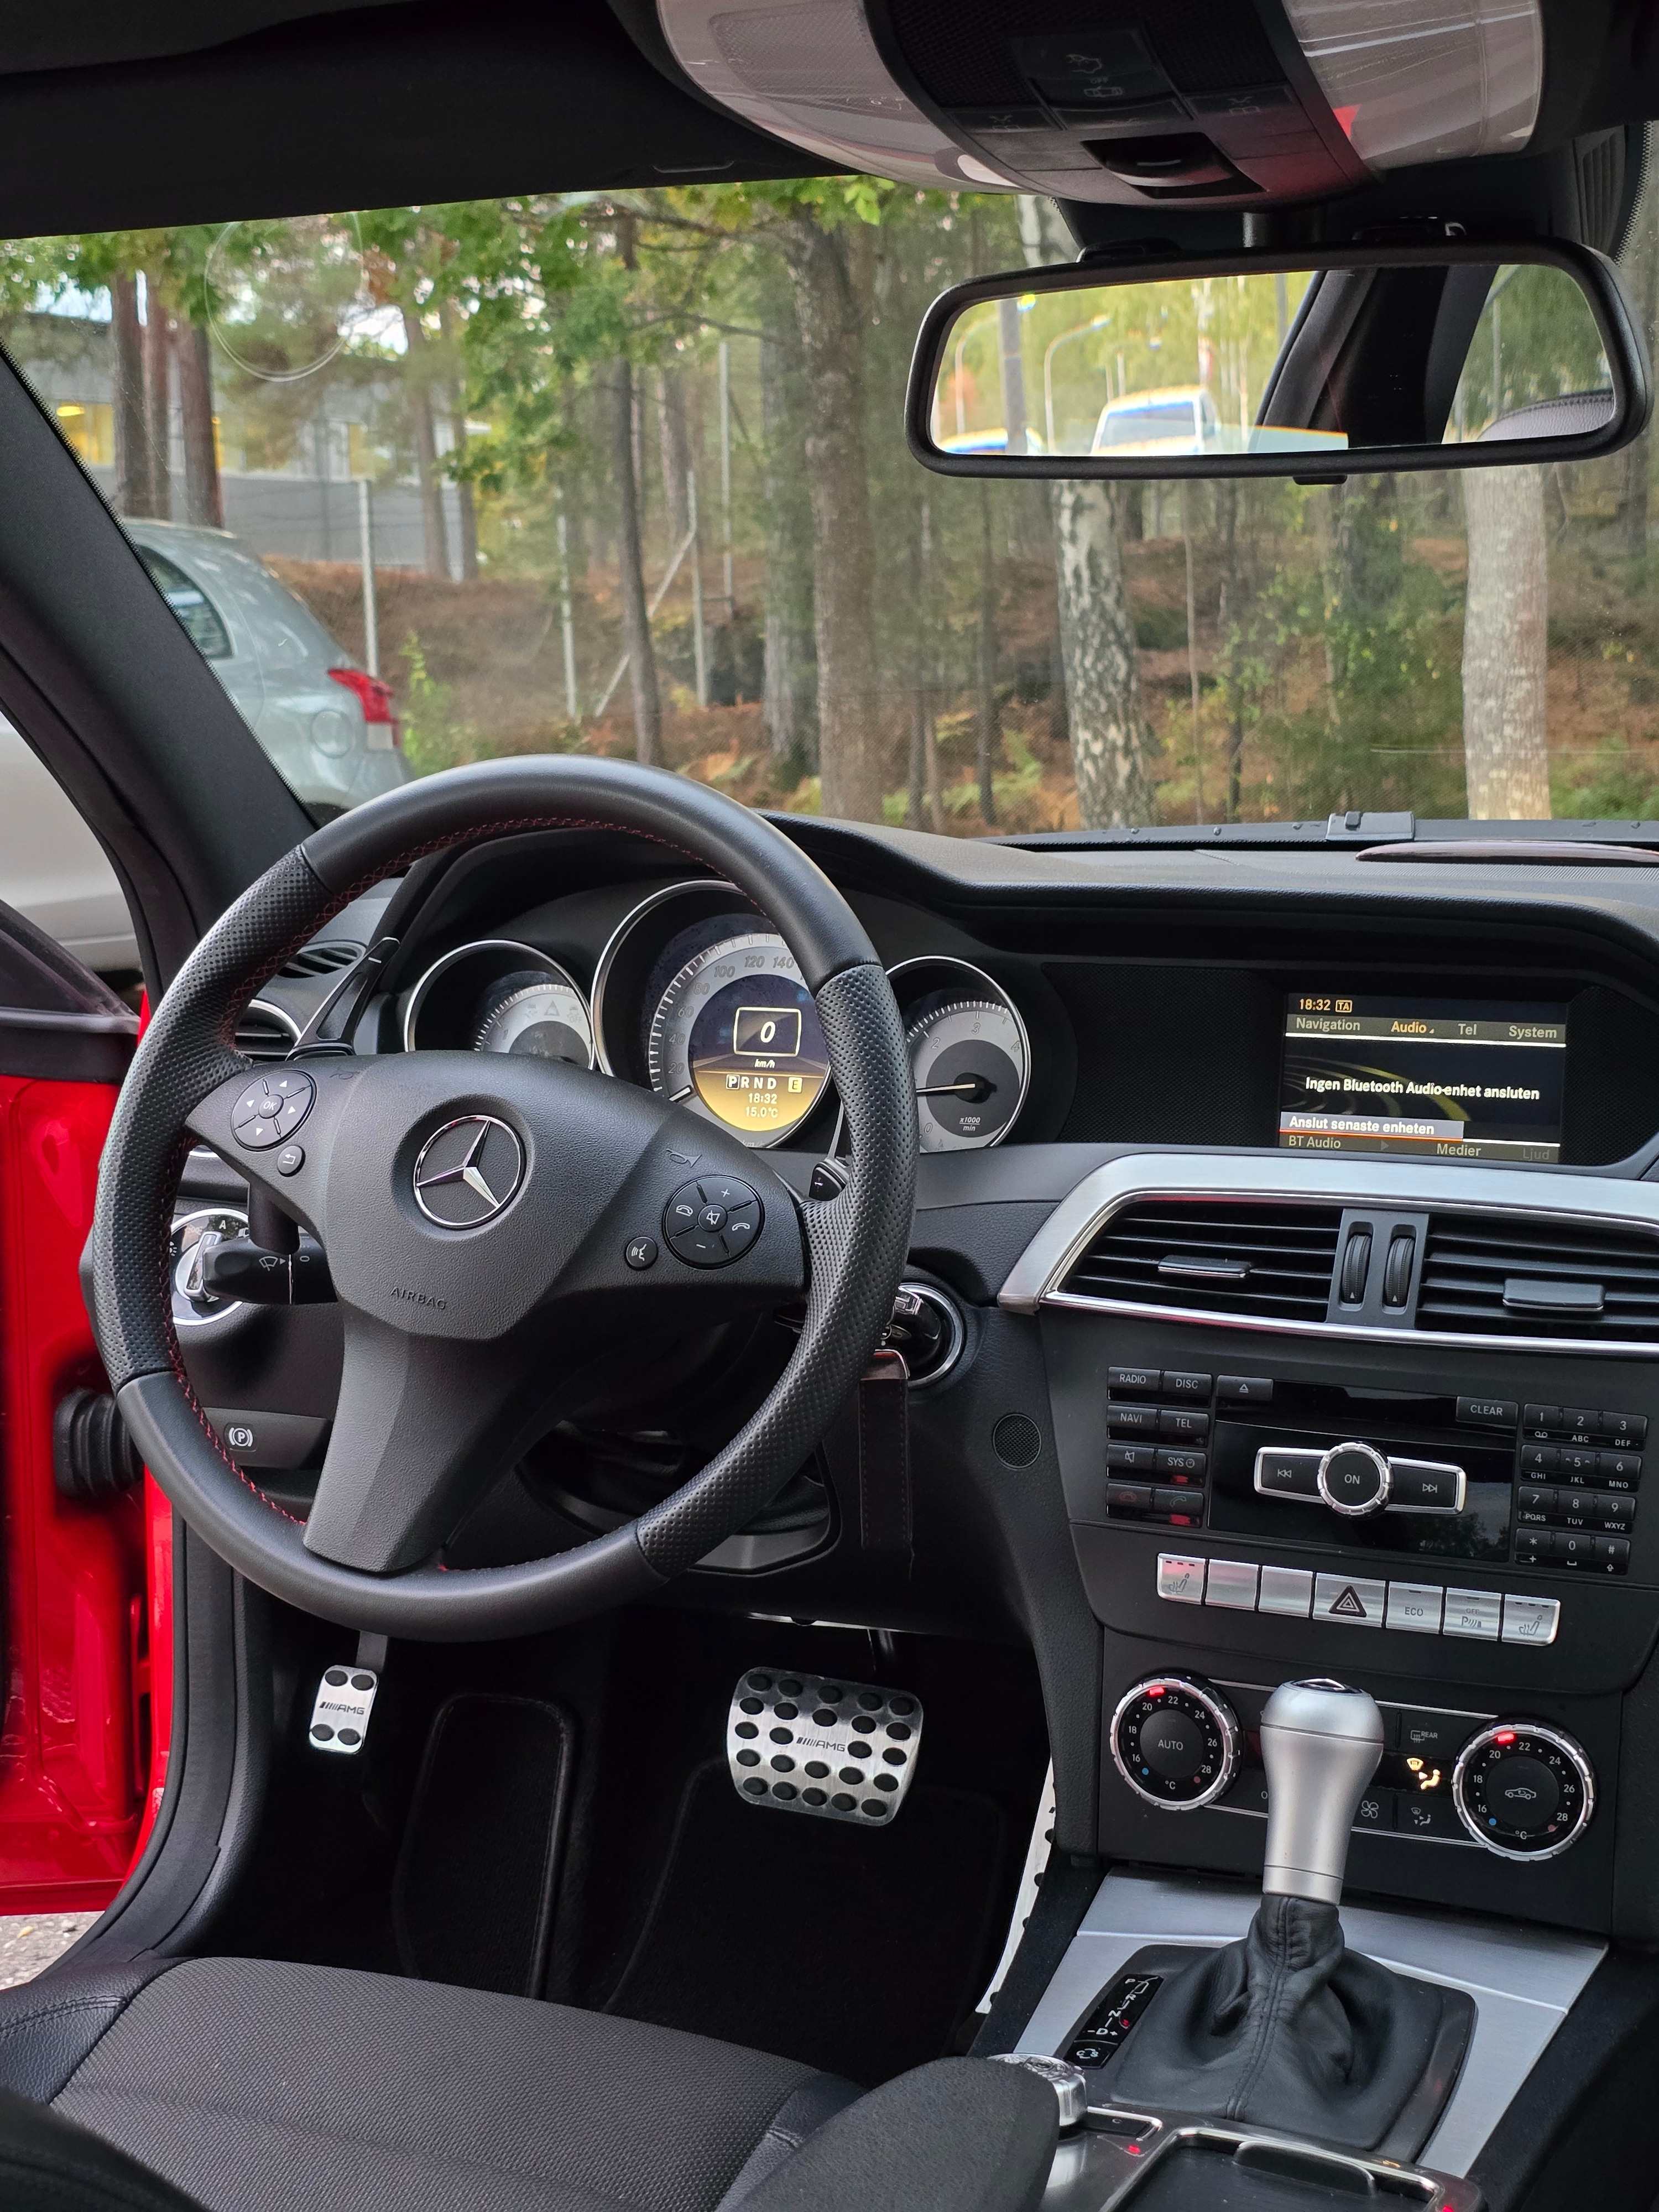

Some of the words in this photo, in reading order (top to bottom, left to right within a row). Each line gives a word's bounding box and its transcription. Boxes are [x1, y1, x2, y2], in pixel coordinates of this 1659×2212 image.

[745, 956, 765, 967] 120
[773, 957, 794, 968] 140
[714, 966, 735, 978] 100
[694, 983, 710, 995] 80
[1299, 999, 1331, 1011] 18:32
[1338, 1002, 1349, 1010] TA
[678, 1006, 694, 1017] 60
[972, 1022, 980, 1034] 3
[1296, 1018, 1360, 1031] Navigation
[1391, 1021, 1427, 1033] Audio
[1458, 1023, 1477, 1035] Tel
[760, 1021, 775, 1042] 0
[1509, 1025, 1557, 1040] System
[669, 1034, 685, 1045] 40
[931, 1038, 940, 1050] 2
[1011, 1040, 1020, 1052] 4
[668, 1063, 685, 1074] 20
[755, 1059, 775, 1068] km/h
[728, 1076, 737, 1087] P
[741, 1077, 749, 1088] R
[754, 1077, 763, 1089] N
[768, 1078, 776, 1089] D
[792, 1080, 798, 1089] E
[1306, 1077, 1340, 1093] Ingen
[1343, 1078, 1404, 1094] Bluetooth
[1484, 1086, 1540, 1100] ansluten
[749, 1093, 777, 1104] 18:32
[263, 1101, 277, 1110] OK
[746, 1107, 778, 1118] 15.0°C
[925, 1123, 932, 1134] 0
[1289, 1116, 1328, 1129] Anslut
[1331, 1119, 1379, 1133] senaste
[1383, 1121, 1434, 1135] enheten
[1288, 1136, 1304, 1146] BT
[1306, 1136, 1341, 1149] Audio
[1437, 1144, 1481, 1156] Medier
[1522, 1147, 1549, 1161] Ljud
[219, 1220, 226, 1229] A
[390, 1286, 447, 1310] AIRBAG
[1119, 1374, 1146, 1384] RADIO
[1176, 1379, 1198, 1389] DISC
[1470, 1405, 1503, 1416] CLEAR
[1120, 1413, 1142, 1423] NAVI
[1540, 1412, 1543, 1421] 1
[1577, 1416, 1584, 1426] 2
[1176, 1418, 1192, 1428] TEL
[1620, 1421, 1626, 1431] 3
[1167, 1457, 1184, 1467] SYS
[1535, 1453, 1542, 1463] 4
[1574, 1458, 1581, 1467] 5
[1616, 1462, 1623, 1471] 6
[1344, 1474, 1360, 1484] ON
[1609, 1480, 1629, 1489] MNO
[1532, 1494, 1540, 1504] 7
[1572, 1499, 1579, 1509] 8
[1611, 1503, 1619, 1512] 9
[1604, 1522, 1625, 1530] WXYZ
[1568, 1541, 1575, 1550] 0
[1405, 1607, 1423, 1616] ECO
[1168, 1696, 1178, 1705] 22
[1142, 1702, 1152, 1711] 20
[1194, 1710, 1205, 1719] 24
[1158, 1739, 1183, 1751] AUTO
[1208, 1738, 1217, 1747] 26
[1519, 1742, 1530, 1751] 22
[1133, 1754, 1140, 1762] 16
[1489, 1750, 1501, 1759] 20
[1550, 1756, 1561, 1765] 24
[1201, 1765, 1211, 1774] 28
[1165, 1781, 1176, 1790] °C
[1564, 1785, 1575, 1793] 26
[1478, 1804, 1487, 1813] 16
[1557, 1813, 1568, 1821] 28
